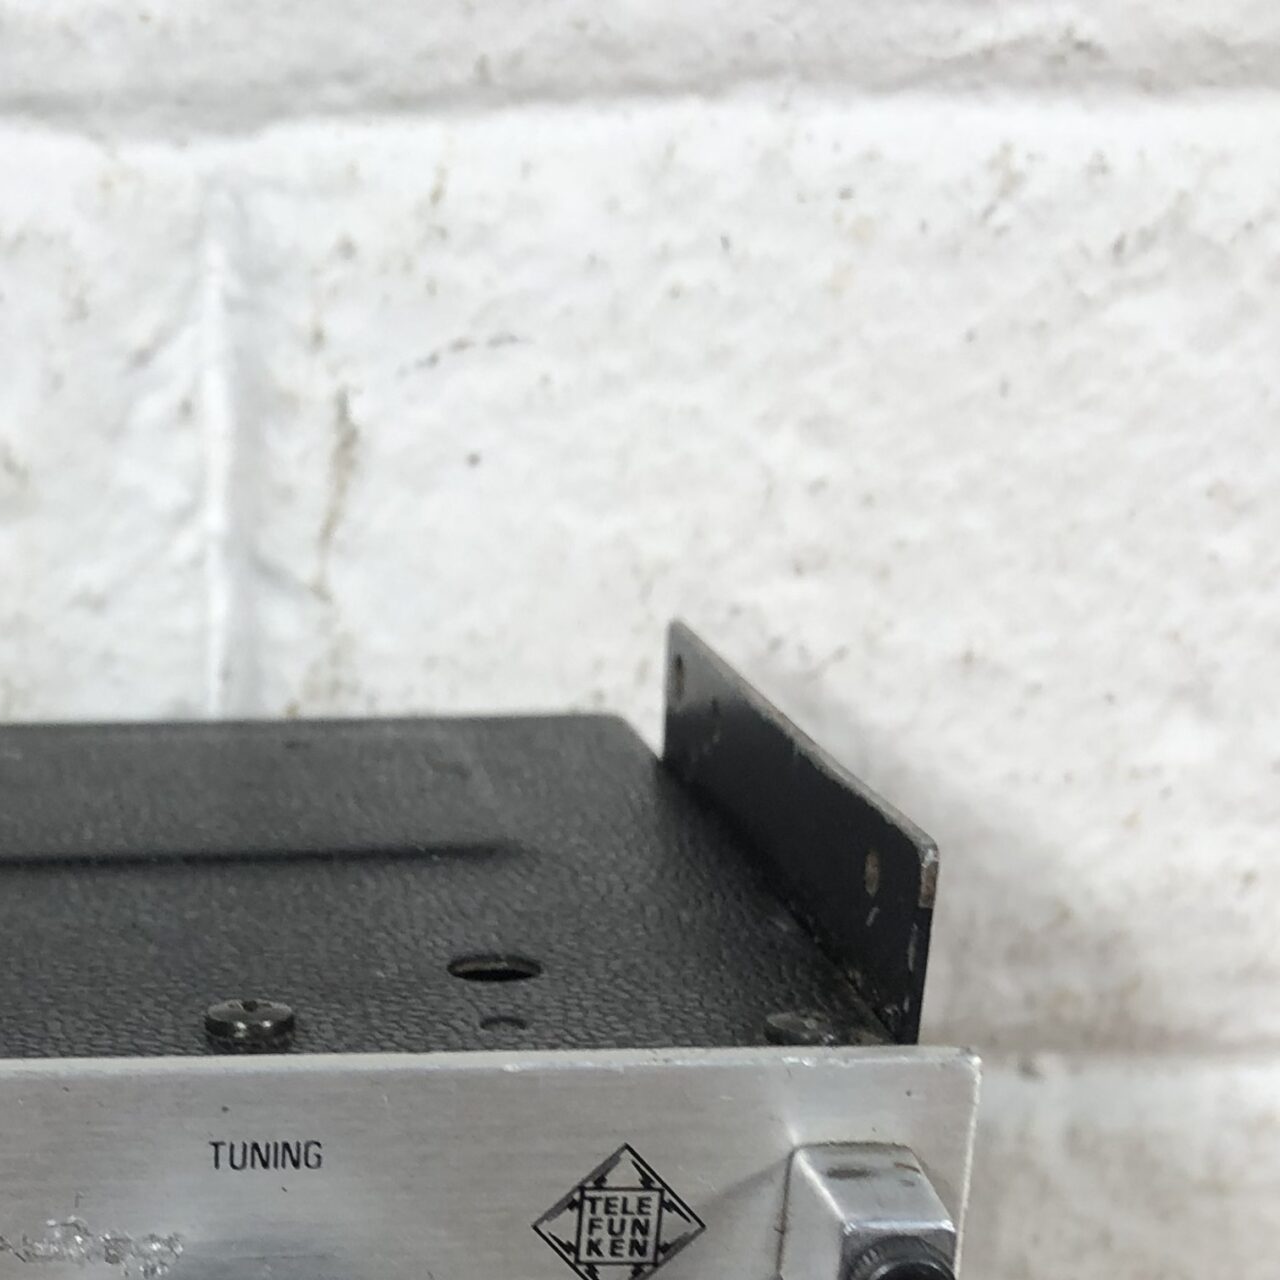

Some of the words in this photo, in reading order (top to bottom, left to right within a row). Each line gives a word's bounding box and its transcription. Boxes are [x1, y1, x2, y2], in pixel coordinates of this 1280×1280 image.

[210, 1140, 325, 1171] TUNING
[584, 1196, 652, 1216] TELE
[588, 1217, 650, 1236] FUN
[586, 1238, 648, 1257] KEN
